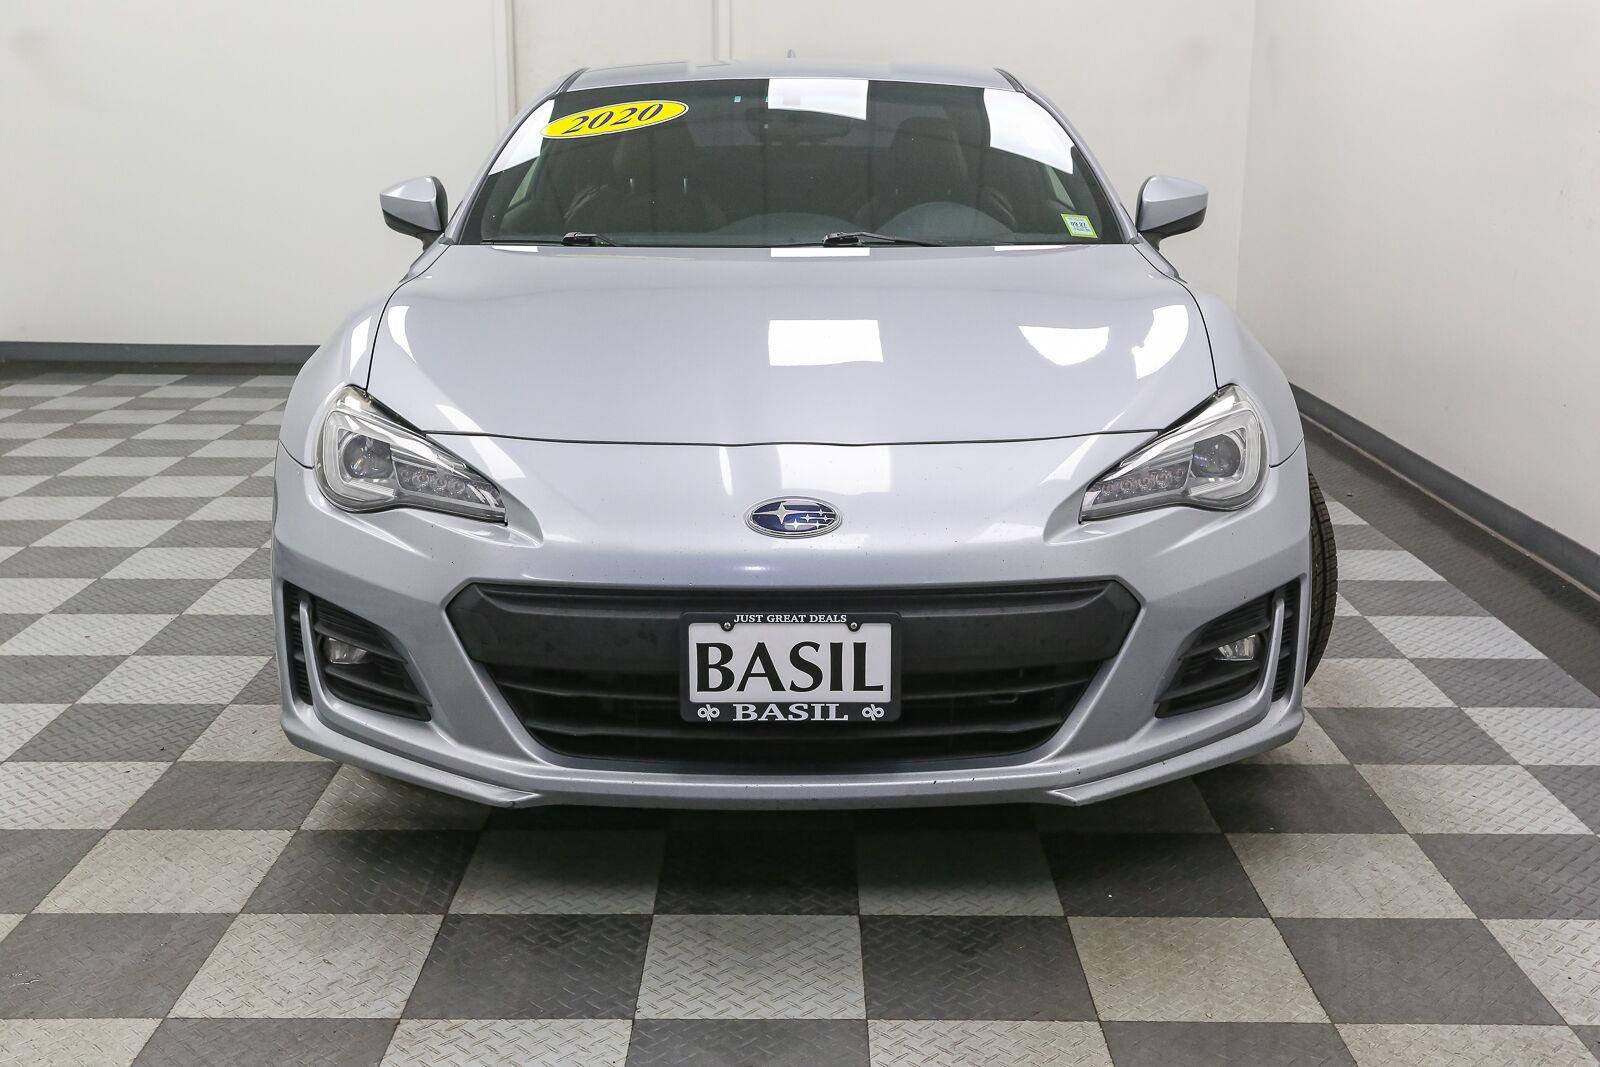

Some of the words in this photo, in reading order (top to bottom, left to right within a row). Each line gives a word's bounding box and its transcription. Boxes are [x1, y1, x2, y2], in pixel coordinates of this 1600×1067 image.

[562, 103, 664, 135] 2020
[733, 614, 764, 624] JUST
[766, 614, 807, 624] GREAT
[809, 614, 847, 624] DEALS
[695, 641, 884, 692] BASIL
[732, 703, 849, 721] BASIL
